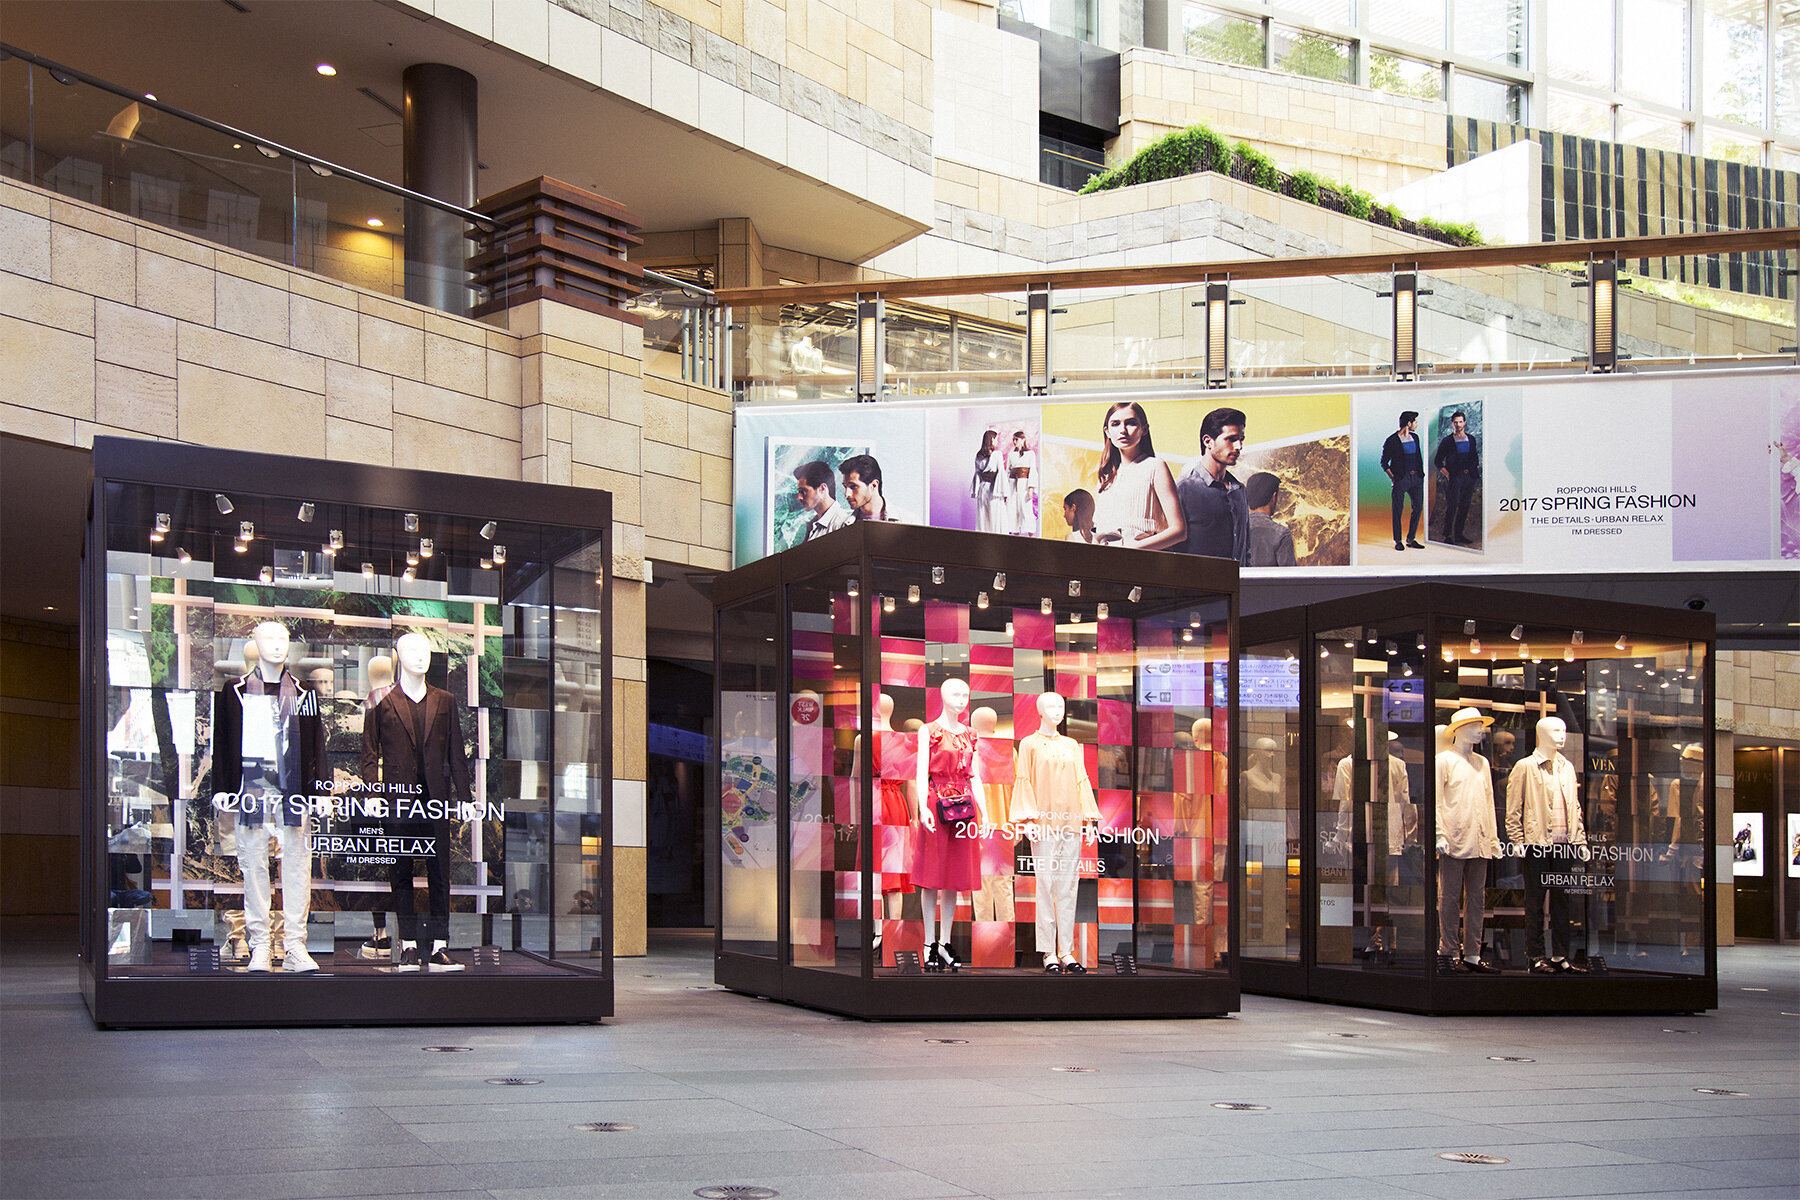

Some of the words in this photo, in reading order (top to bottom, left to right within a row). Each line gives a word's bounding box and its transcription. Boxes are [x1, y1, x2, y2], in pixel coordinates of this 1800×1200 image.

[1557, 486, 1607, 495] ROPPONGI
[1610, 485, 1637, 493] HILLS
[1499, 498, 1538, 511] 2017
[1542, 496, 1611, 511] SPRING
[1615, 494, 1696, 509] FASHION
[1531, 517, 1550, 525] THE
[1631, 514, 1664, 523] RELAX
[315, 780, 386, 793] ROPPONGI
[389, 783, 423, 794] HILLS
[225, 793, 284, 814] 2017
[289, 795, 390, 818] SPRING
[396, 798, 505, 822] FASHION
[359, 827, 384, 835] MEN'S
[954, 821, 998, 840] 2017
[1002, 822, 1075, 841] SPRING
[1080, 826, 1160, 845] FASHION
[304, 836, 371, 853] URBAN
[376, 839, 436, 854] RELAX
[346, 856, 358, 864] I'M
[358, 857, 397, 865] DRESSED
[1532, 844, 1591, 860] SPRING
[1592, 845, 1654, 862] FASHION
[1017, 857, 1046, 871] THE
[1049, 859, 1106, 873] DETAILS
[1540, 873, 1578, 886] URBAN
[1580, 874, 1615, 887] RELAX
